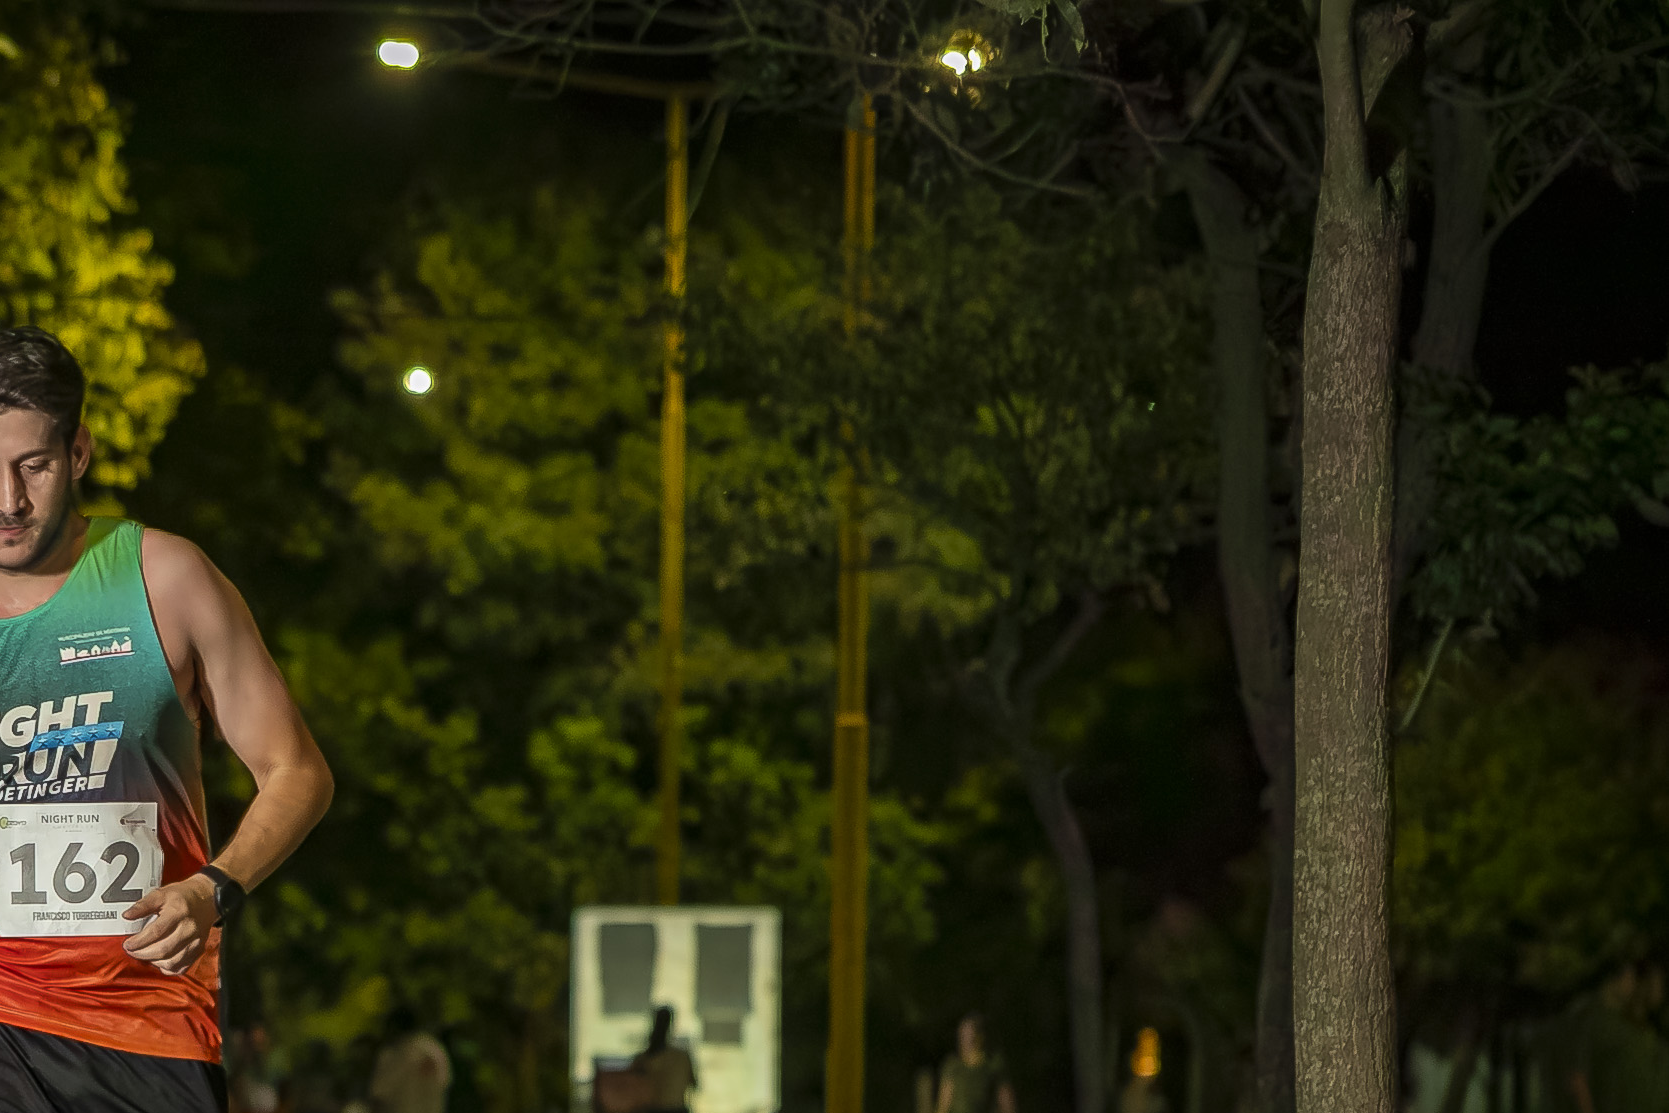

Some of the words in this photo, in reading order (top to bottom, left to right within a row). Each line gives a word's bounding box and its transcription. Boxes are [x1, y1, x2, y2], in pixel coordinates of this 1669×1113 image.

[41, 814, 73, 824] NIGHT
[76, 814, 100, 824] RUN
[10, 840, 144, 905] 162
